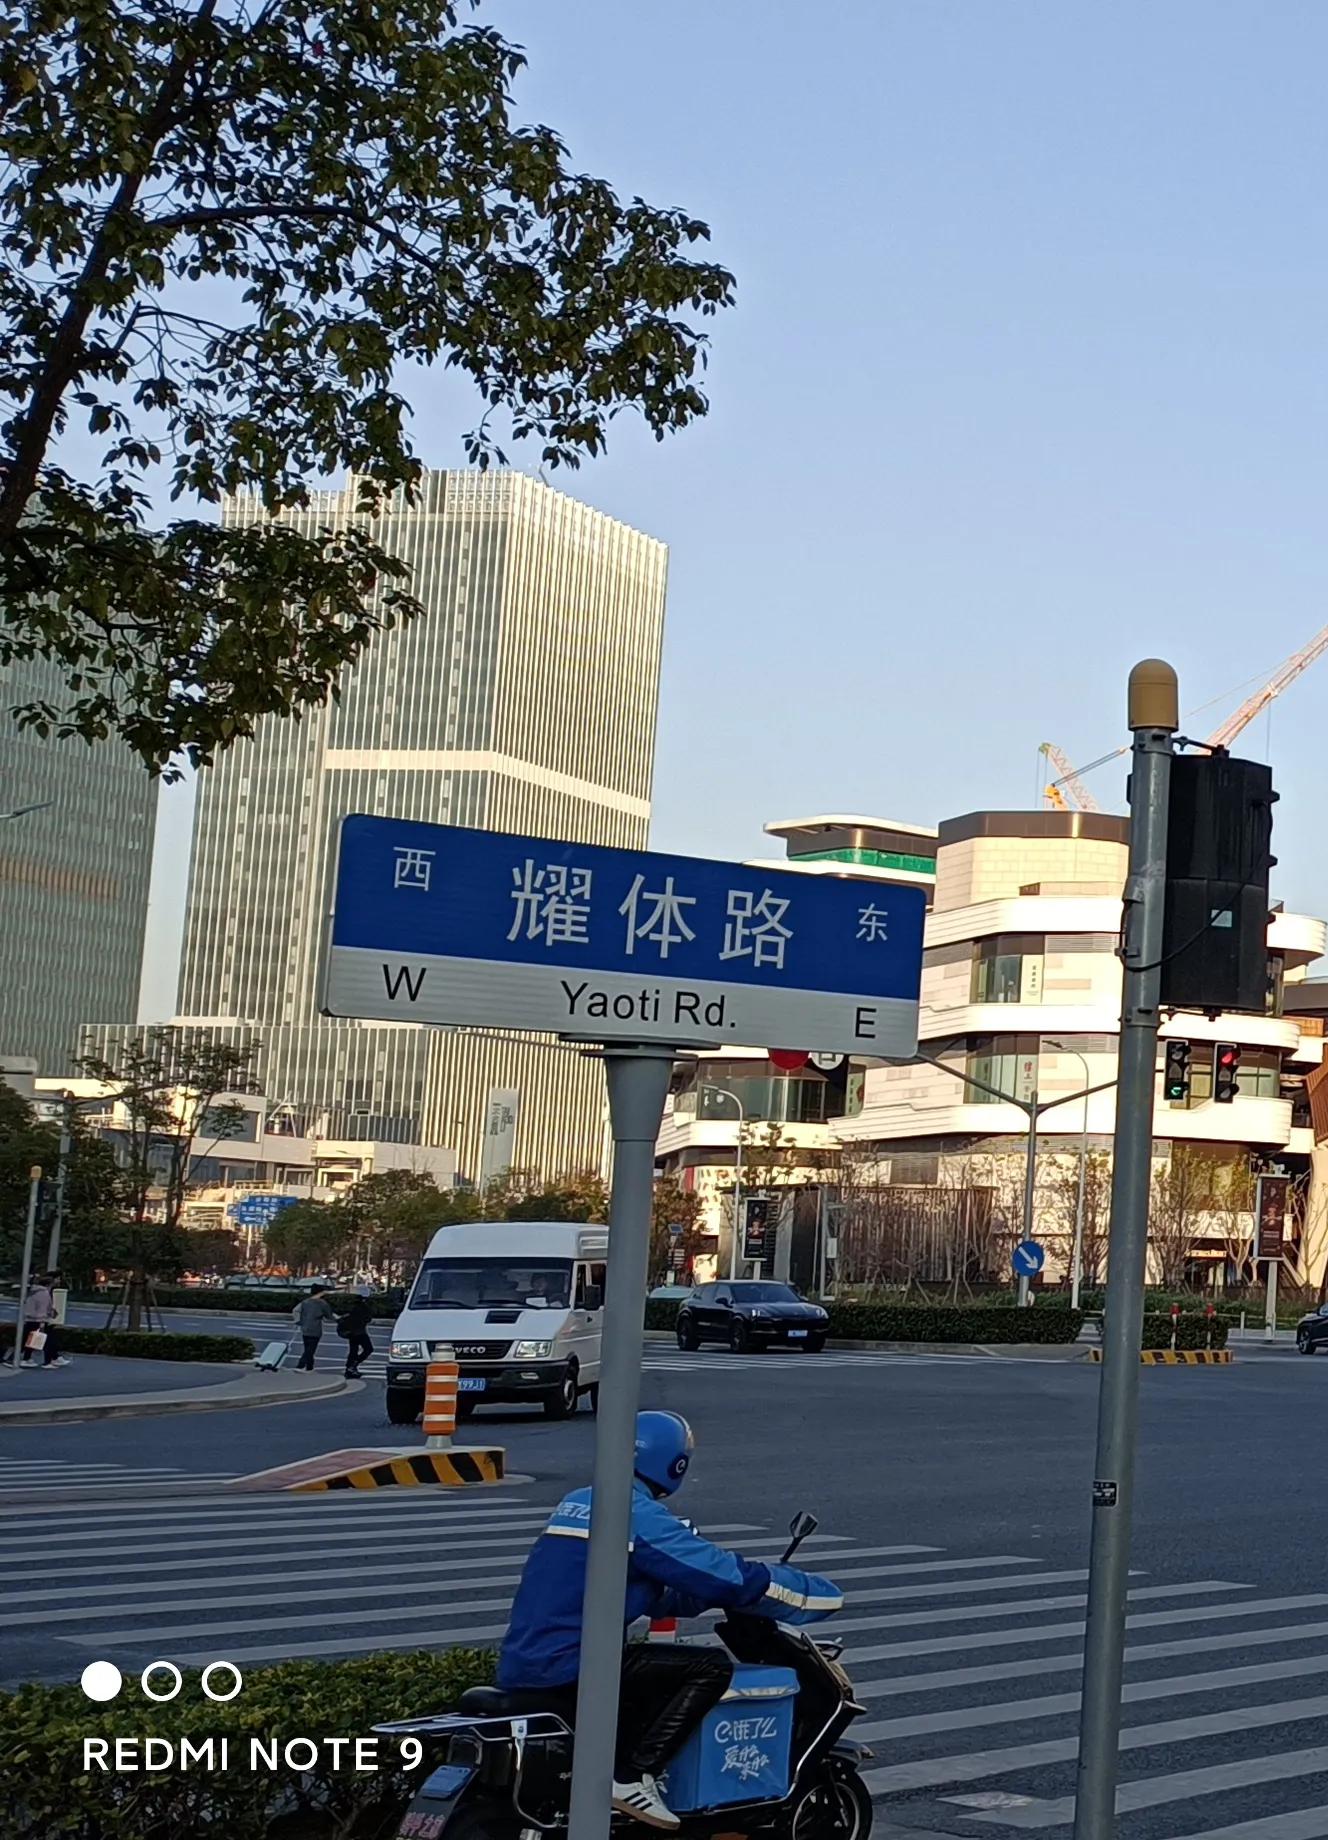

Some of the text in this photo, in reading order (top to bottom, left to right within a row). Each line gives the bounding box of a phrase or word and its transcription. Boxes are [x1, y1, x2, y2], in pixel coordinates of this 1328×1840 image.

[393, 846, 889, 971] 西 耀体路 东
[382, 963, 877, 1039] W Yaoti Rd. E
[452, 1346, 486, 1355] VECO
